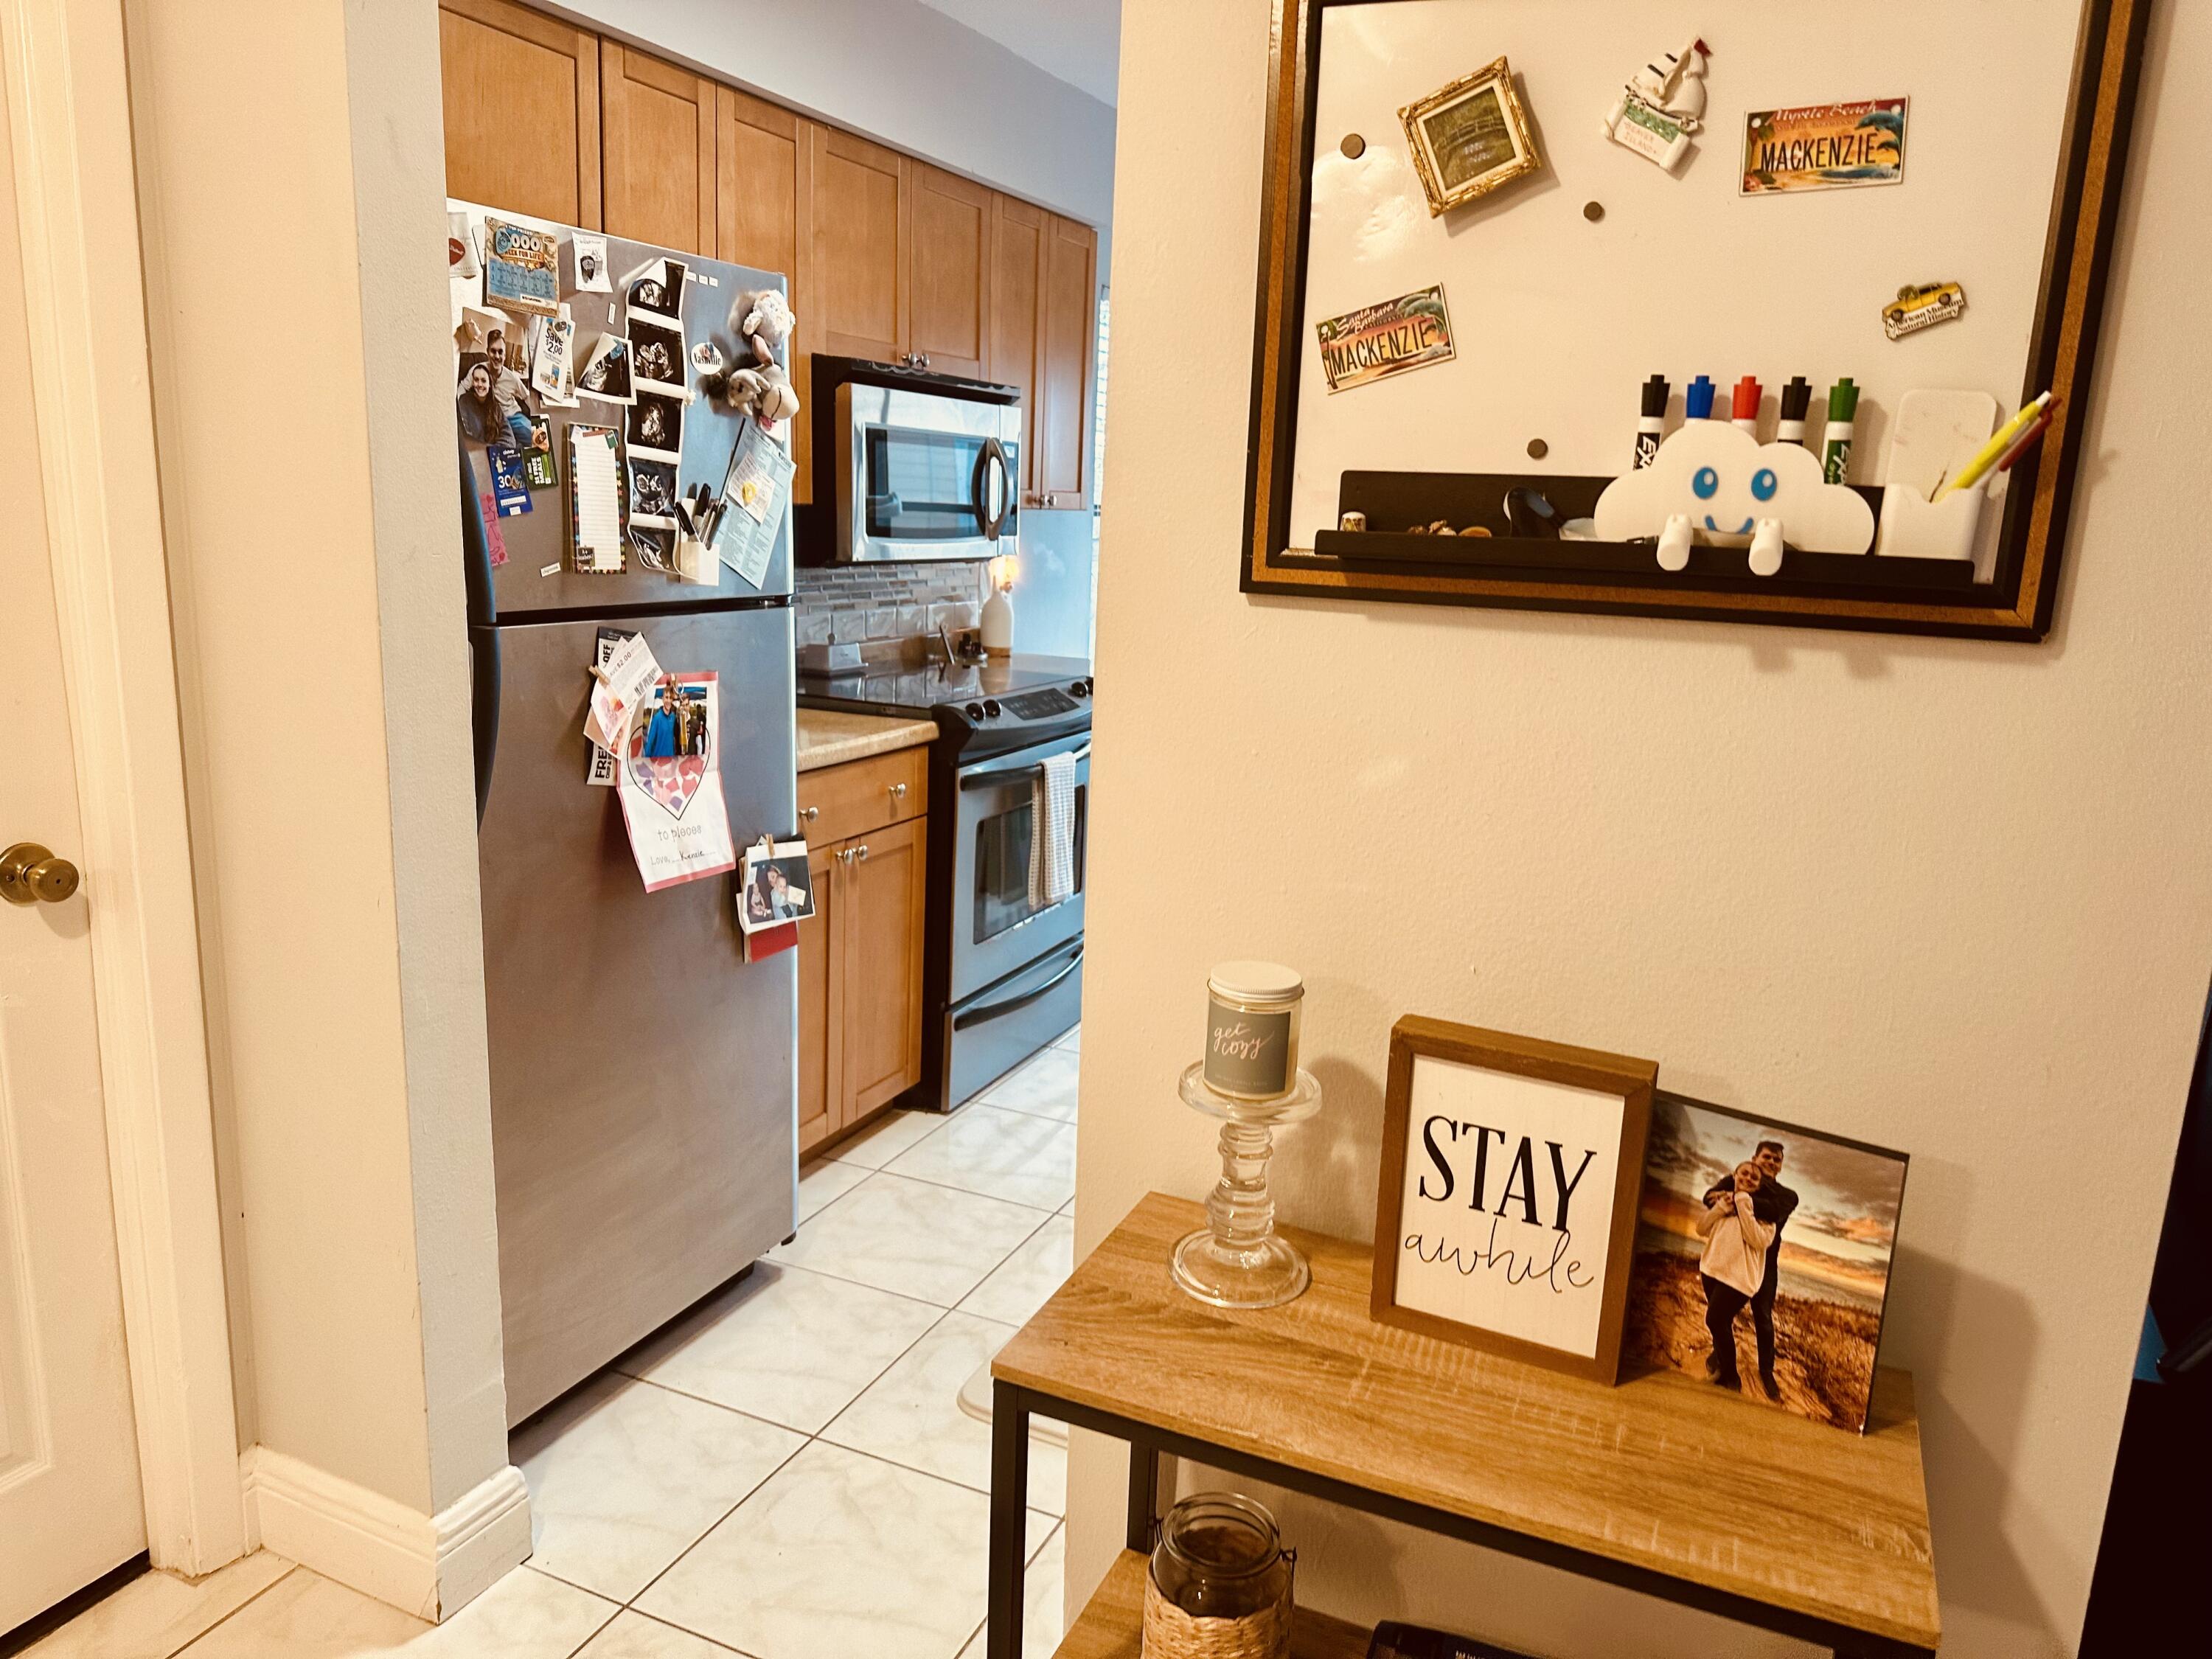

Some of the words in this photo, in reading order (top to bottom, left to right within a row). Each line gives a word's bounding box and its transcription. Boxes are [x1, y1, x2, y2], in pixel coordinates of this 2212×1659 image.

[1830, 100, 1877, 118] Beach
[1761, 133, 1878, 173] MACKENZIE
[1336, 307, 1371, 341] Santa
[1354, 303, 1393, 334] Barbara
[546, 328, 564, 347] Save
[546, 340, 563, 355] $2.00
[1331, 319, 1432, 375] MACKENZIE
[658, 830, 669, 841] to
[1214, 1022, 1251, 1052] get
[1222, 1031, 1275, 1060] cozy
[1419, 1115, 1597, 1231] STAY
[1405, 1217, 1595, 1294] awhile
